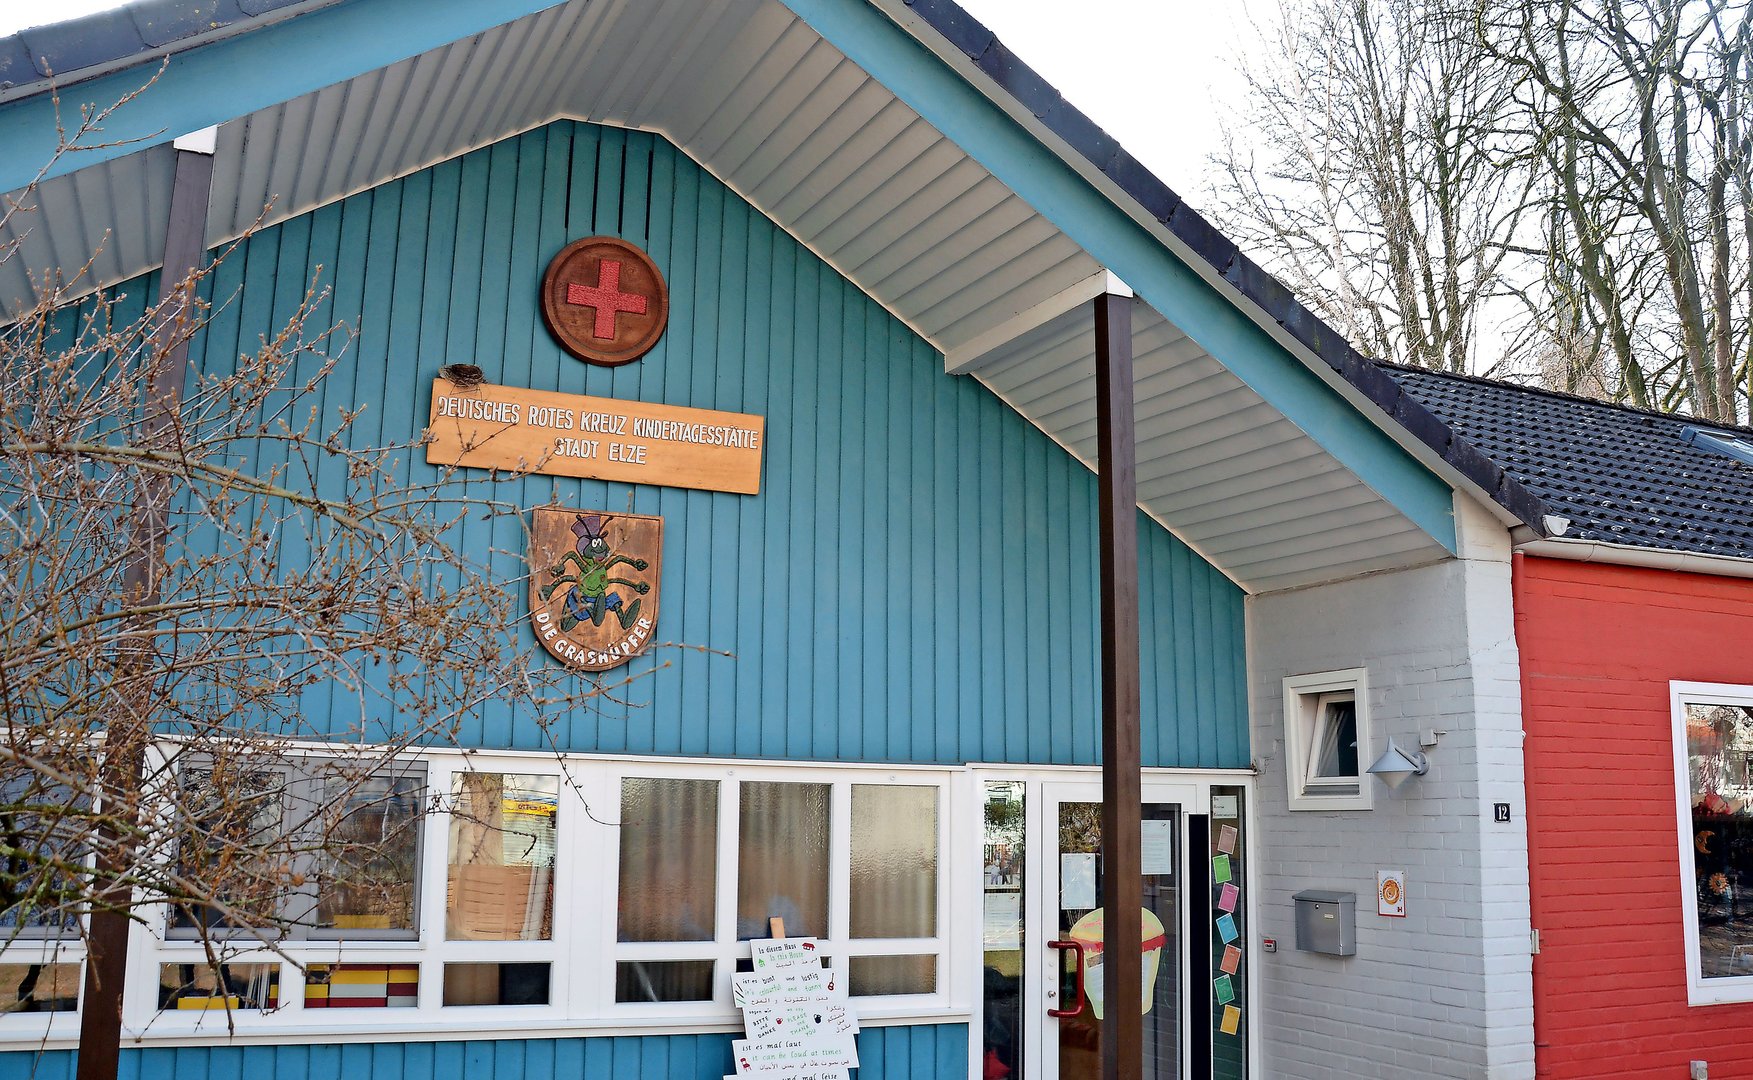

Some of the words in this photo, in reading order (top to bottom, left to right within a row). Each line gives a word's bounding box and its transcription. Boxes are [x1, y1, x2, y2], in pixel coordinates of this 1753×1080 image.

[438, 396, 520, 424] DEUTSCHES
[528, 406, 574, 430] ROTES
[580, 411, 626, 436] KREUZ
[632, 417, 758, 449] KINDERTAGESSTÄTTE
[554, 438, 599, 458] STADT
[608, 443, 646, 464] ELZE
[536, 612, 558, 640] DIE
[554, 617, 653, 665] GRASHÜPFER
[1498, 806, 1508, 820] 12
[752, 1016, 769, 1026] BITTE
[787, 1012, 808, 1022] PLEASE
[757, 1027, 776, 1038] DANKE
[790, 1025, 810, 1035] THANK
[791, 1050, 807, 1058] loud
